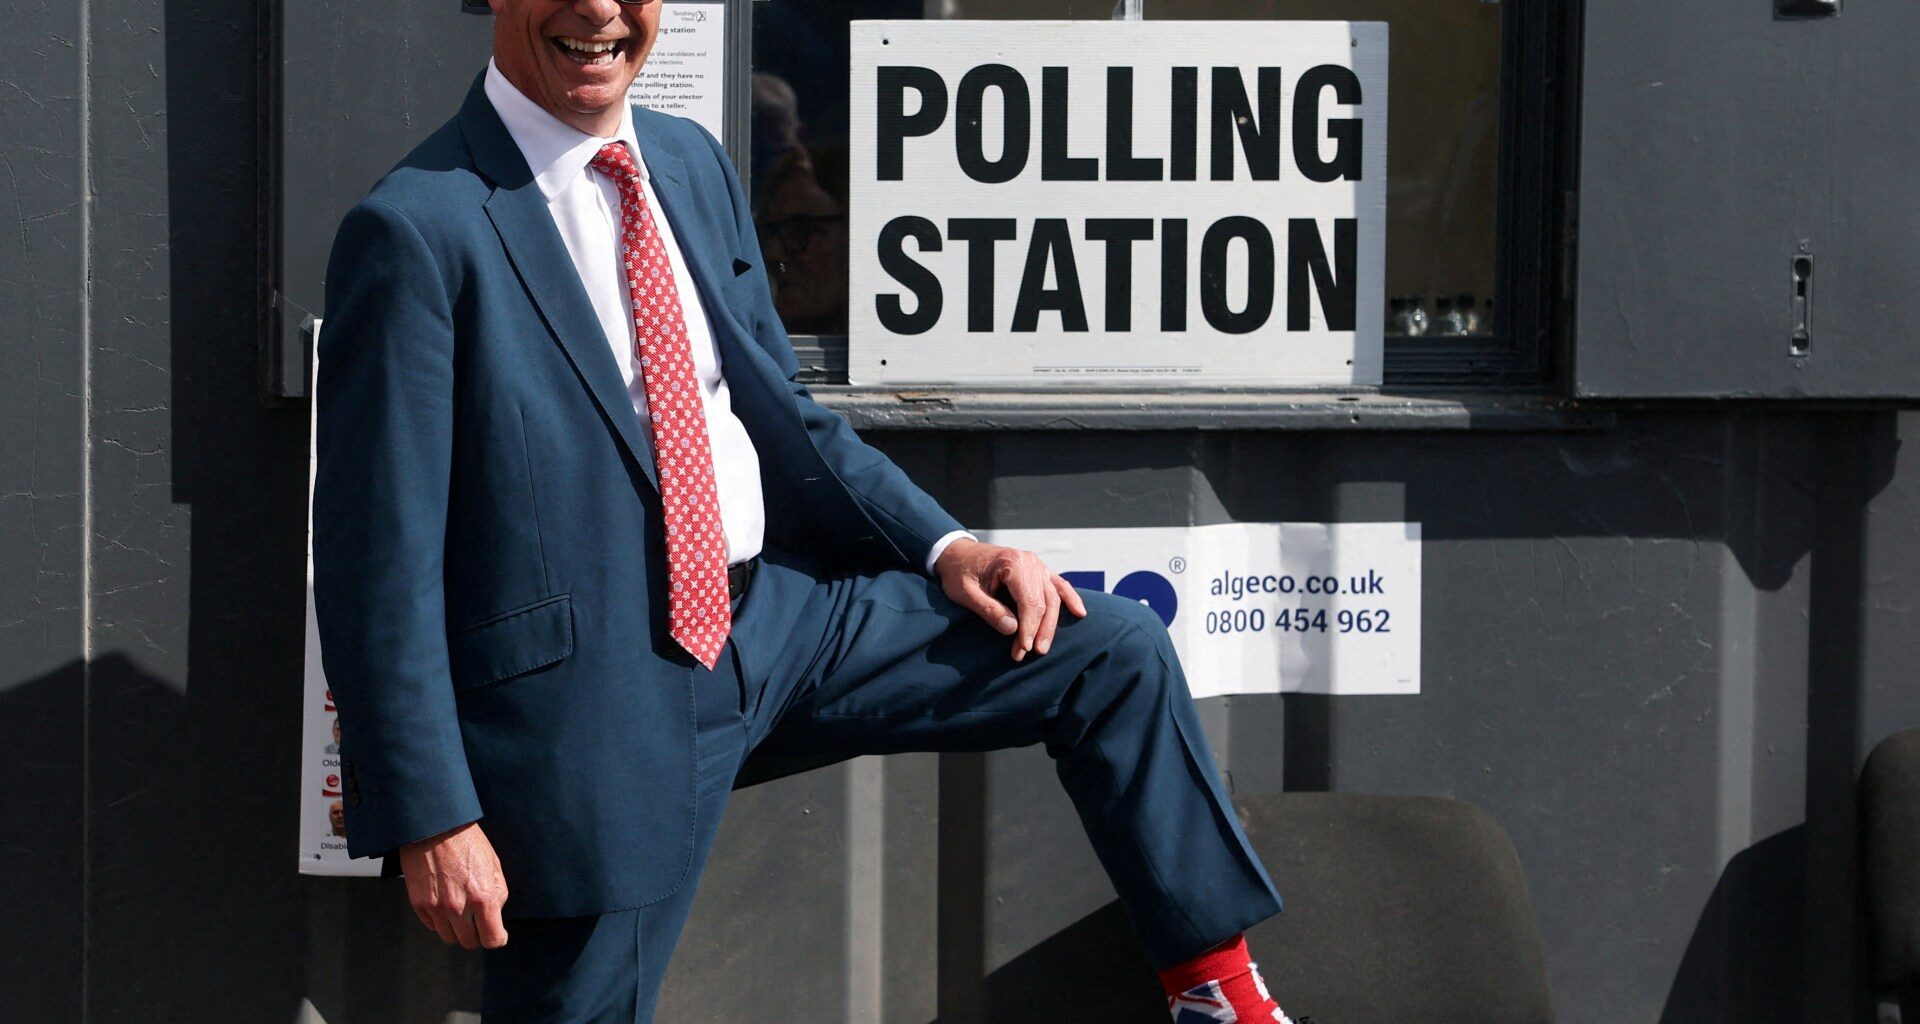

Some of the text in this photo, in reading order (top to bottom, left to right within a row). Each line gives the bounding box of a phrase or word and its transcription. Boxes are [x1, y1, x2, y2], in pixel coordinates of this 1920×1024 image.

[876, 63, 1363, 184] POLLING
[875, 215, 1358, 336] STATION
[1211, 569, 1384, 600] algeco.co.uk
[1206, 608, 1391, 634] 0800 454 962
[321, 842, 348, 850] Disabl
